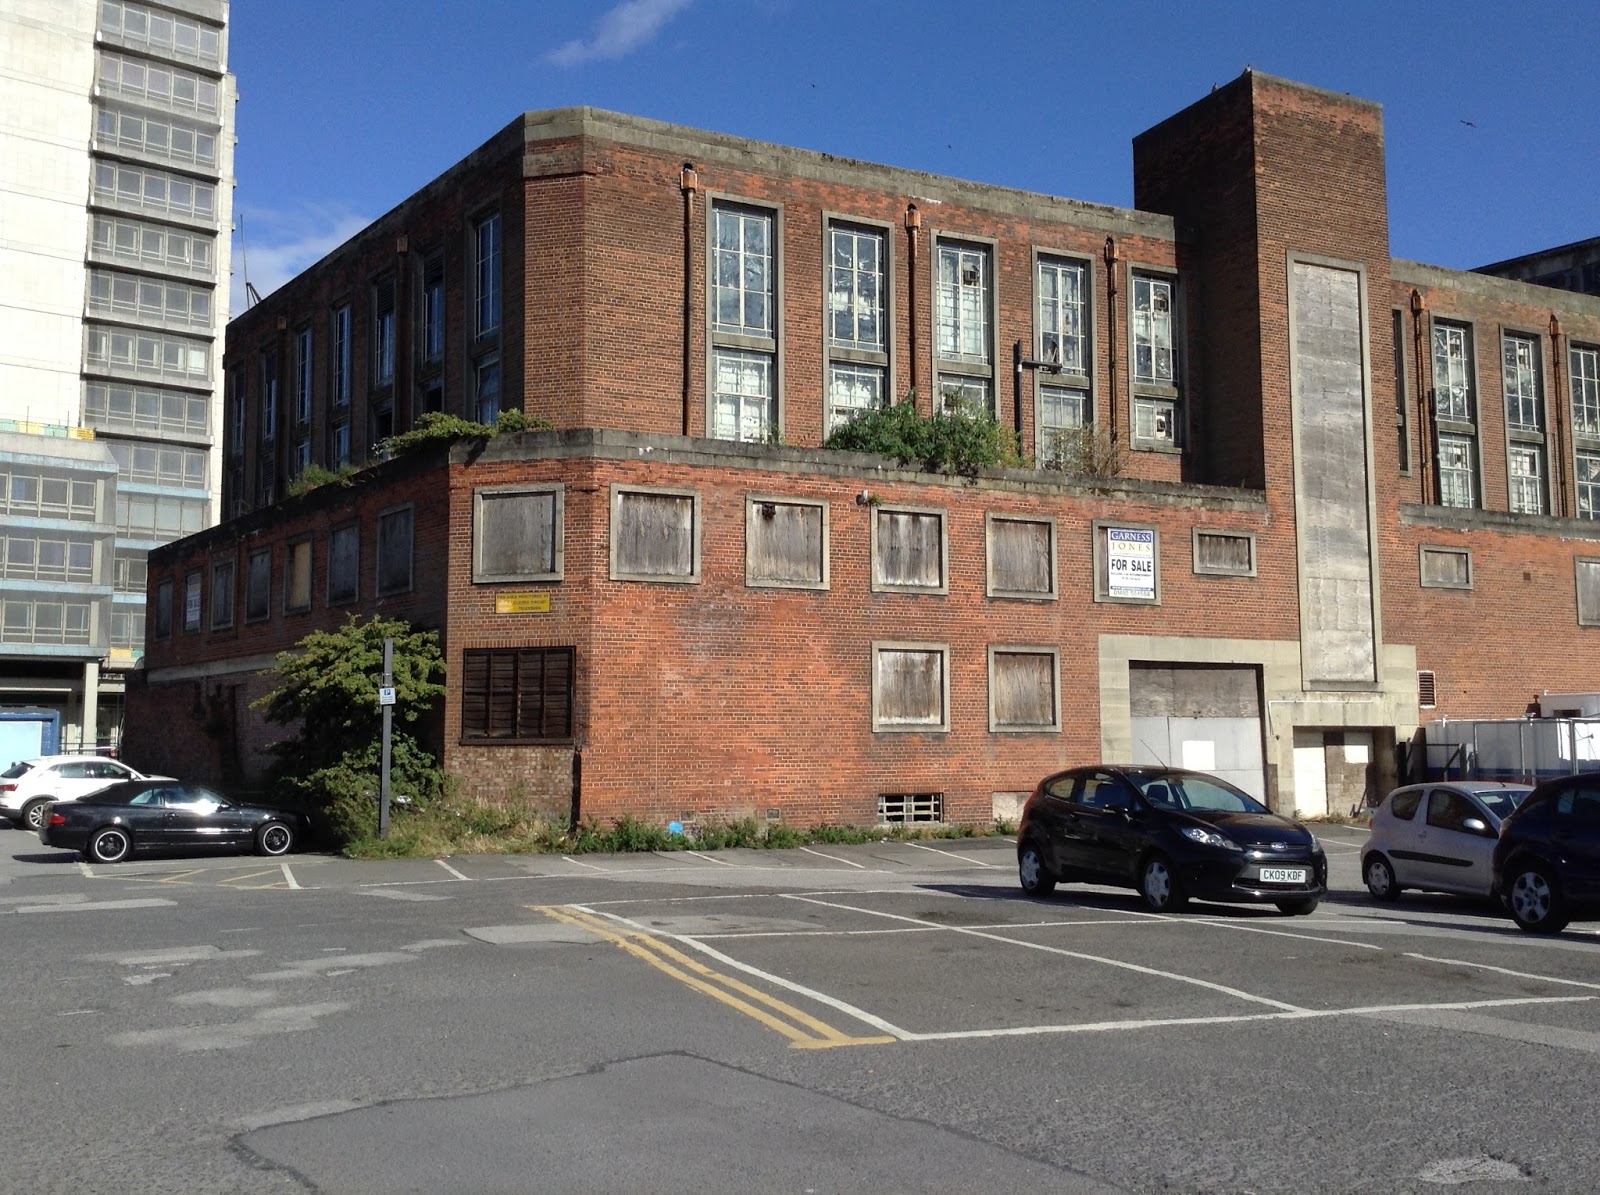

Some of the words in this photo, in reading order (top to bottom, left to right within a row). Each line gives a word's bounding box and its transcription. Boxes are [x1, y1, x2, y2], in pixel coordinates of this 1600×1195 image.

[1111, 532, 1151, 541] GARNESS
[1112, 542, 1150, 551] JONES
[1111, 559, 1128, 571] FOR
[1131, 560, 1152, 572] SALE
[1263, 869, 1286, 880] CK09
[1287, 870, 1303, 880] KDF
